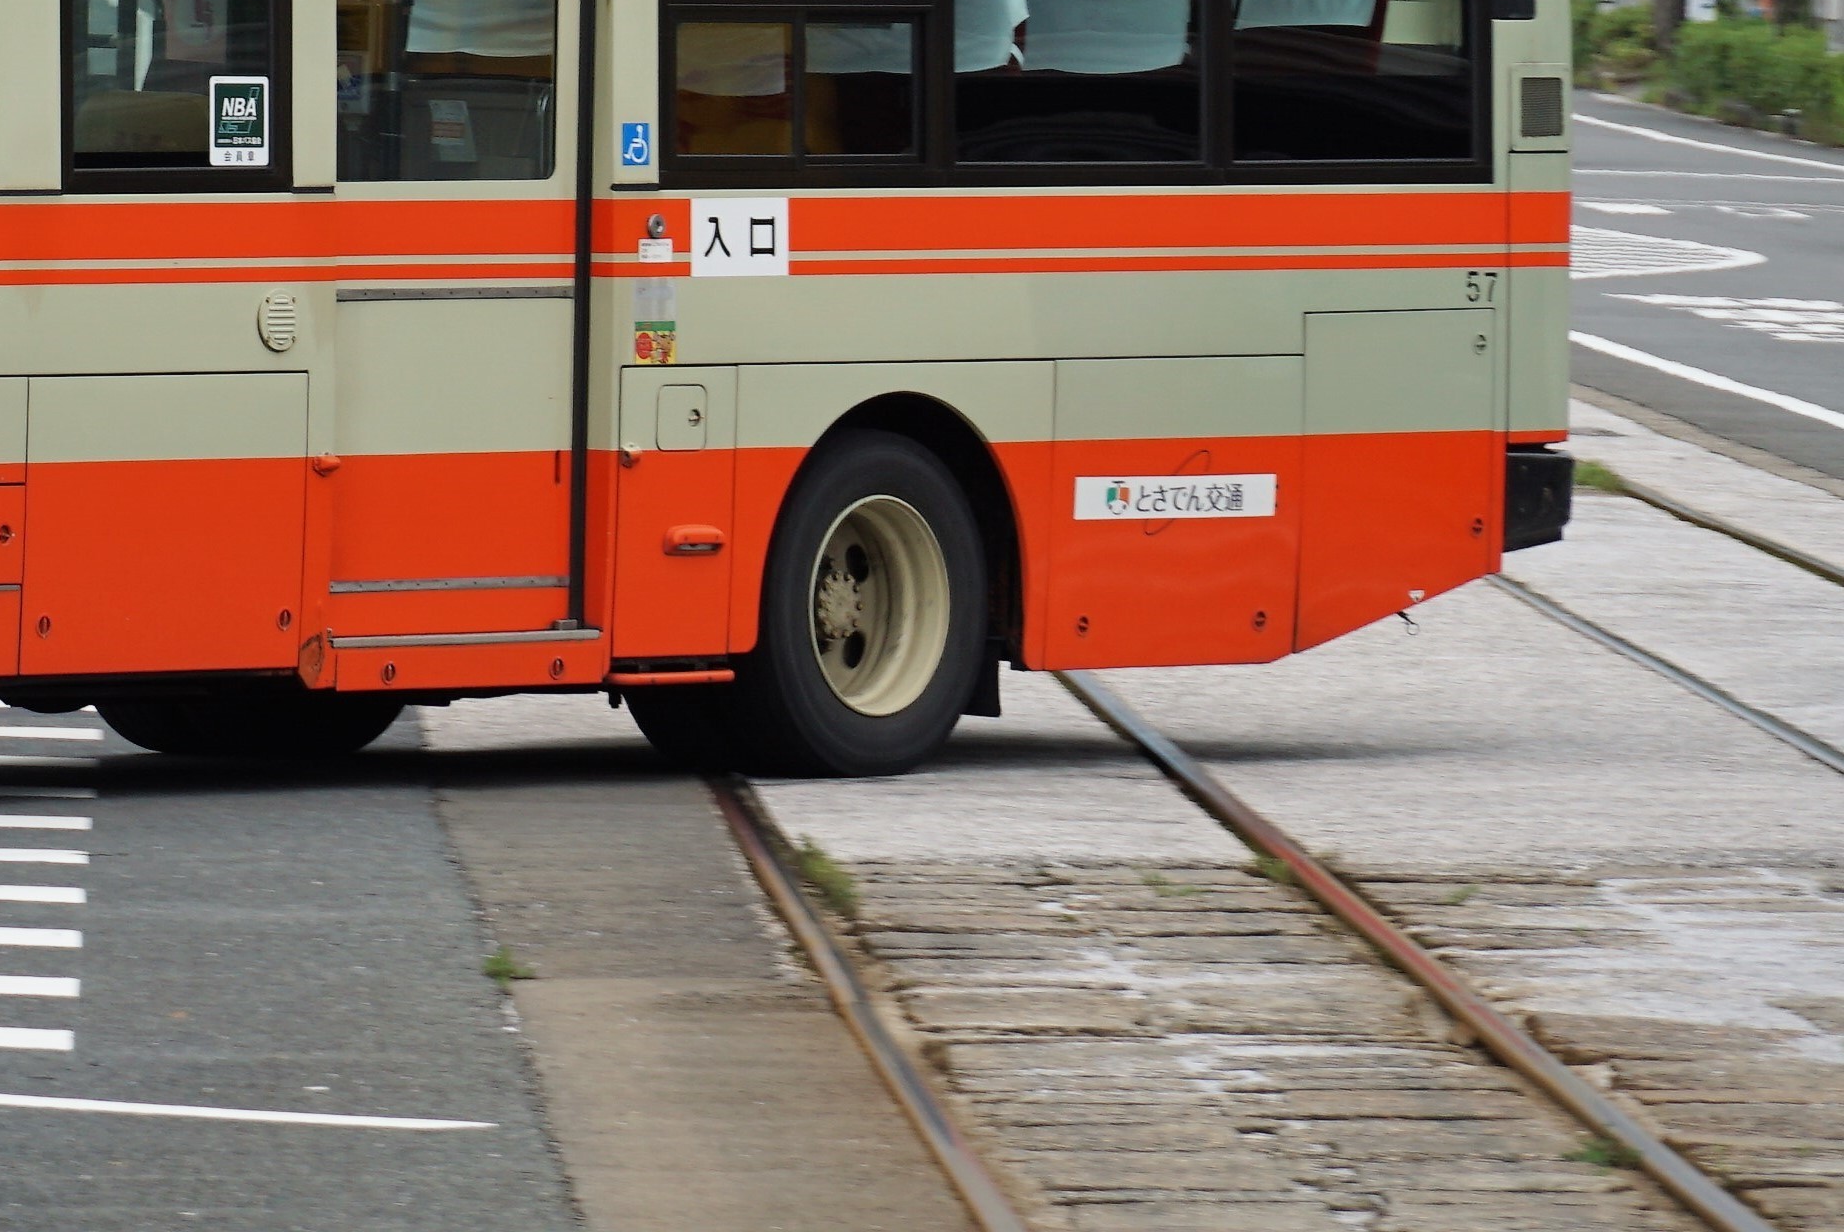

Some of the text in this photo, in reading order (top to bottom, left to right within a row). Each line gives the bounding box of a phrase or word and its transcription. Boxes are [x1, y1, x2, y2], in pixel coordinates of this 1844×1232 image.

[221, 97, 257, 117] NBA
[705, 217, 776, 257] 入口
[1466, 270, 1498, 303] 57
[1136, 483, 1244, 513] とさでん交通
